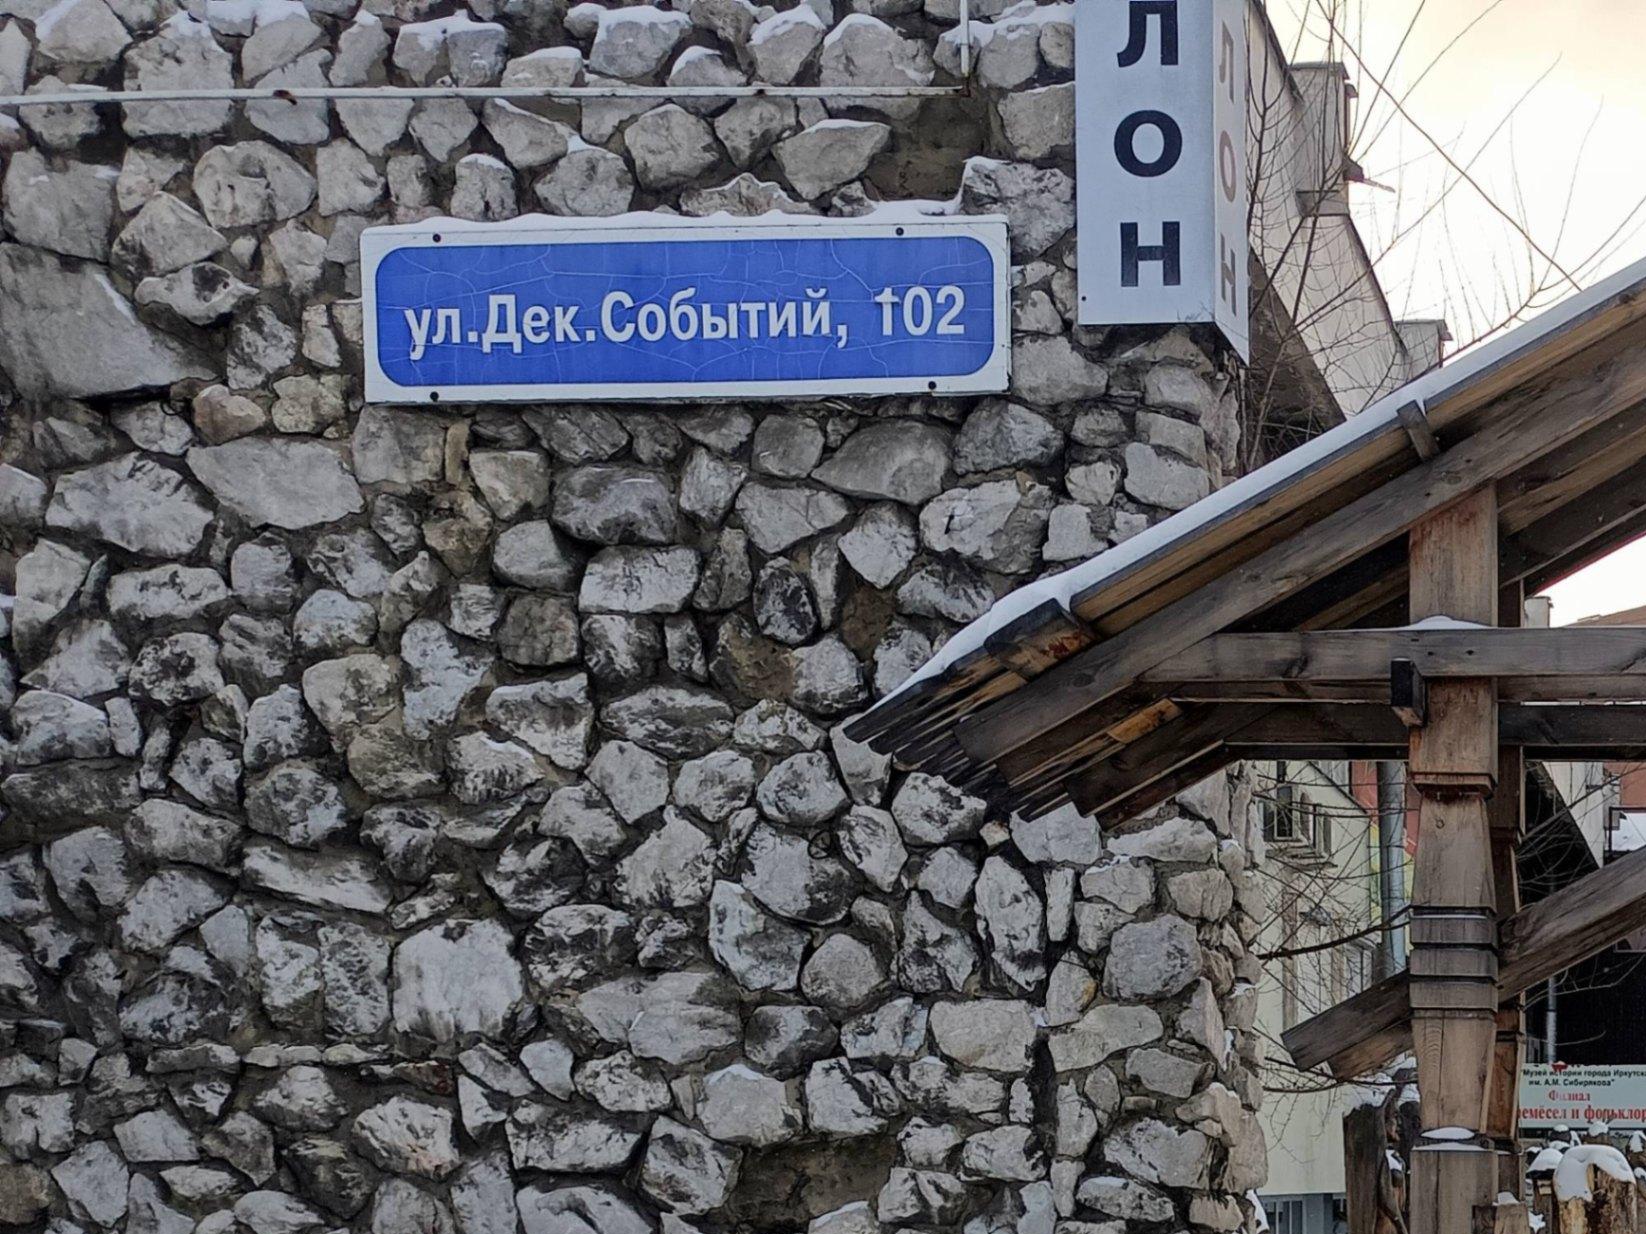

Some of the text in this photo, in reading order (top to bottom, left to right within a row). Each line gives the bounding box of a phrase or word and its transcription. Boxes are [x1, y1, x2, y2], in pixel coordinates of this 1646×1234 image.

[874, 284, 967, 338] 102
[1584, 1069, 1611, 1078] города
[1571, 1107, 1580, 1120] и
